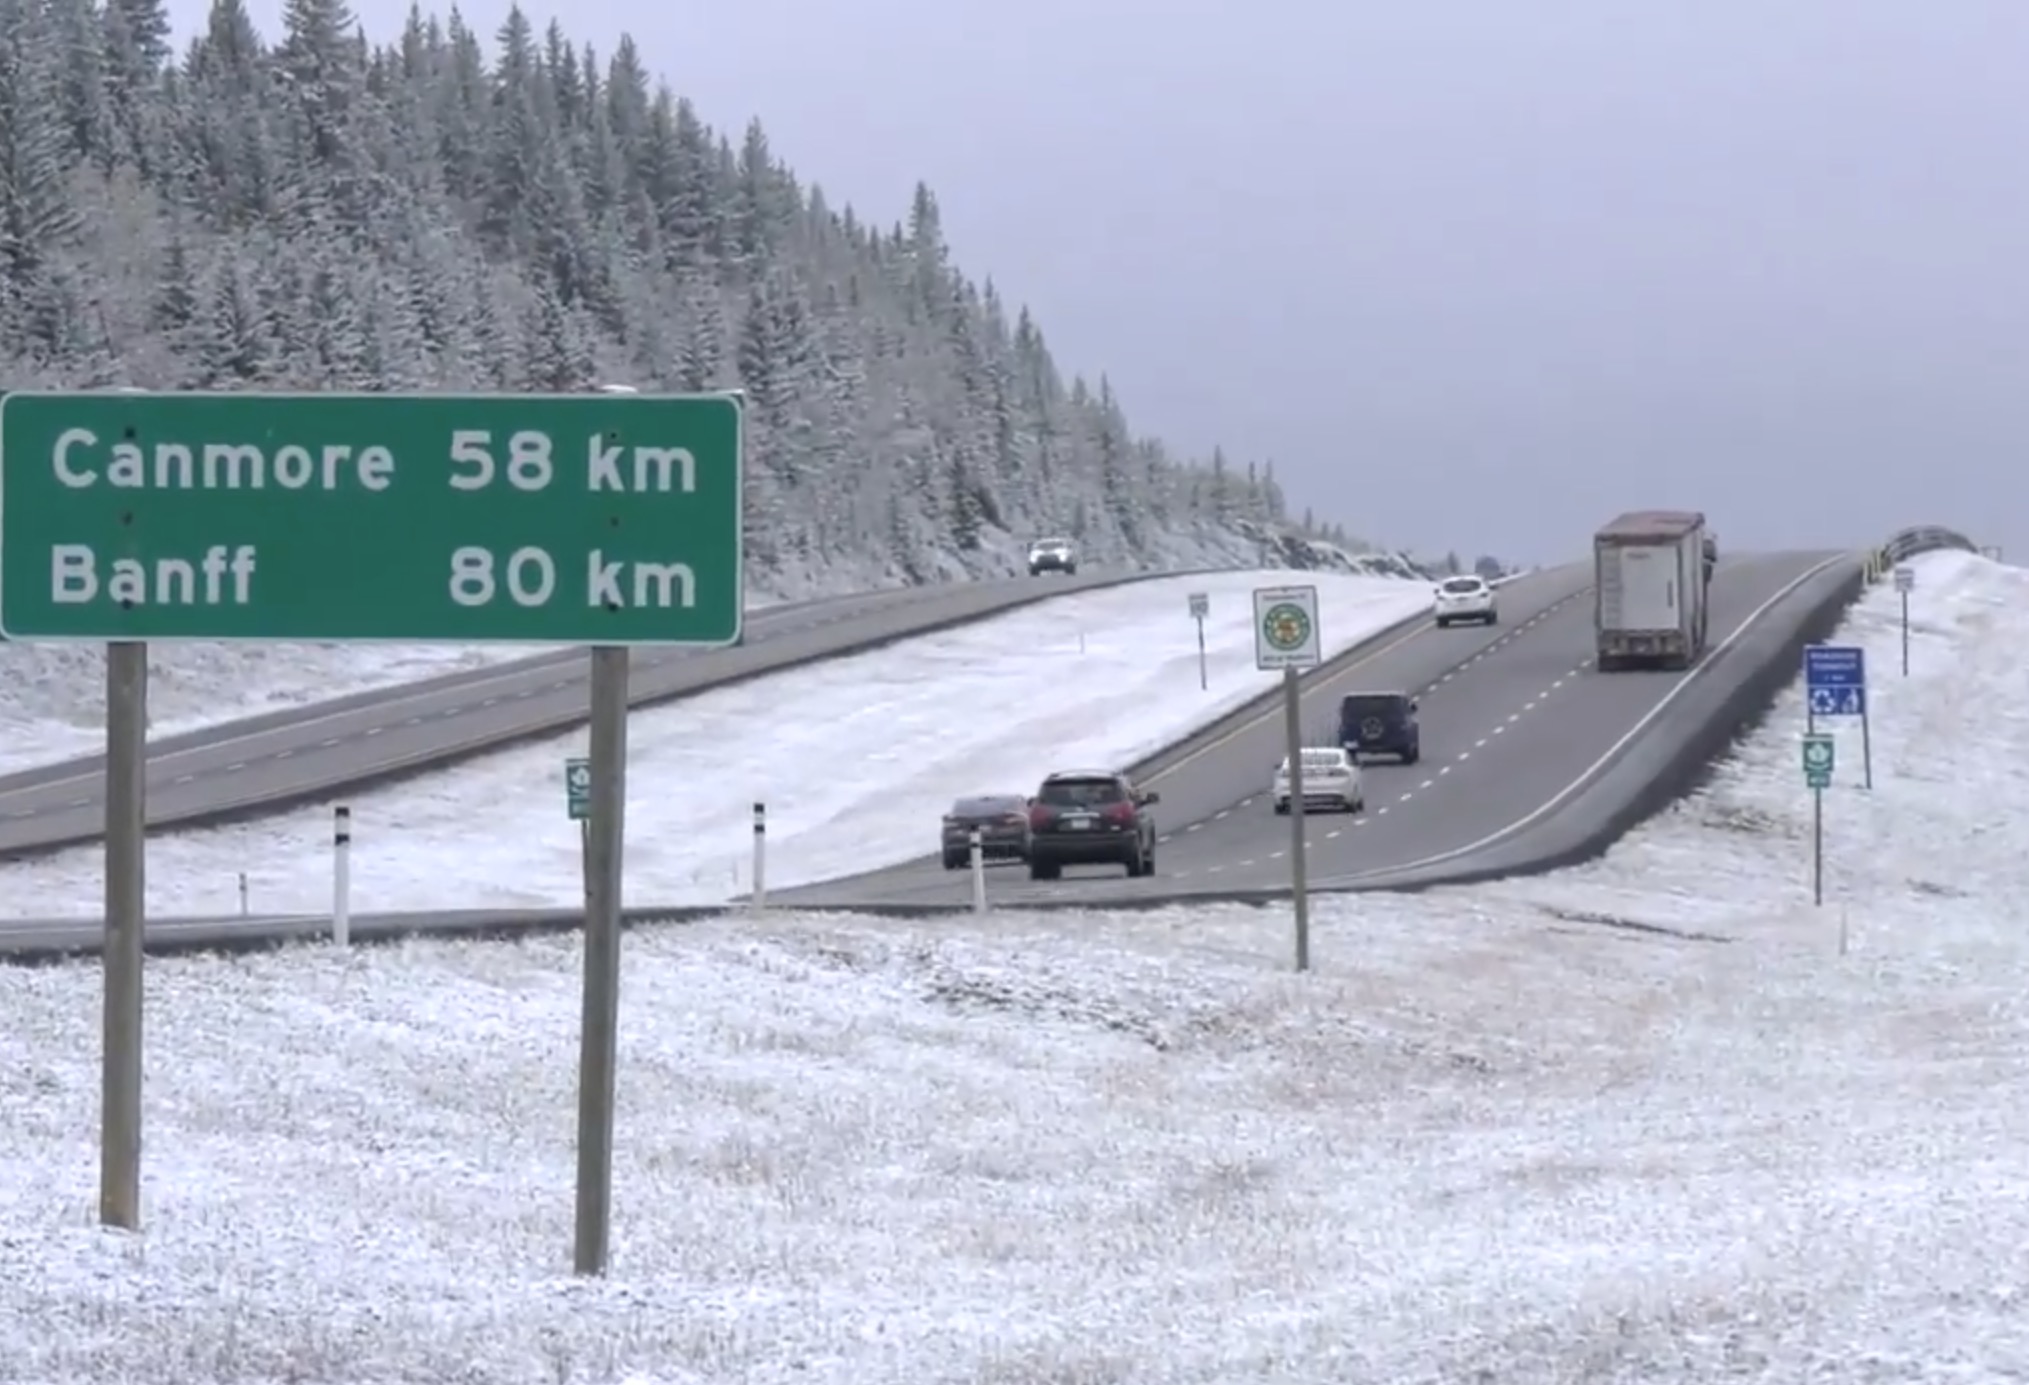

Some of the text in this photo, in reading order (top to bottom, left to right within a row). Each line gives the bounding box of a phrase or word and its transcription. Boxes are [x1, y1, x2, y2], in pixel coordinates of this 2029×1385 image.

[52, 428, 696, 492] Canmore 58 km
[51, 544, 696, 608] Banff 80 km
